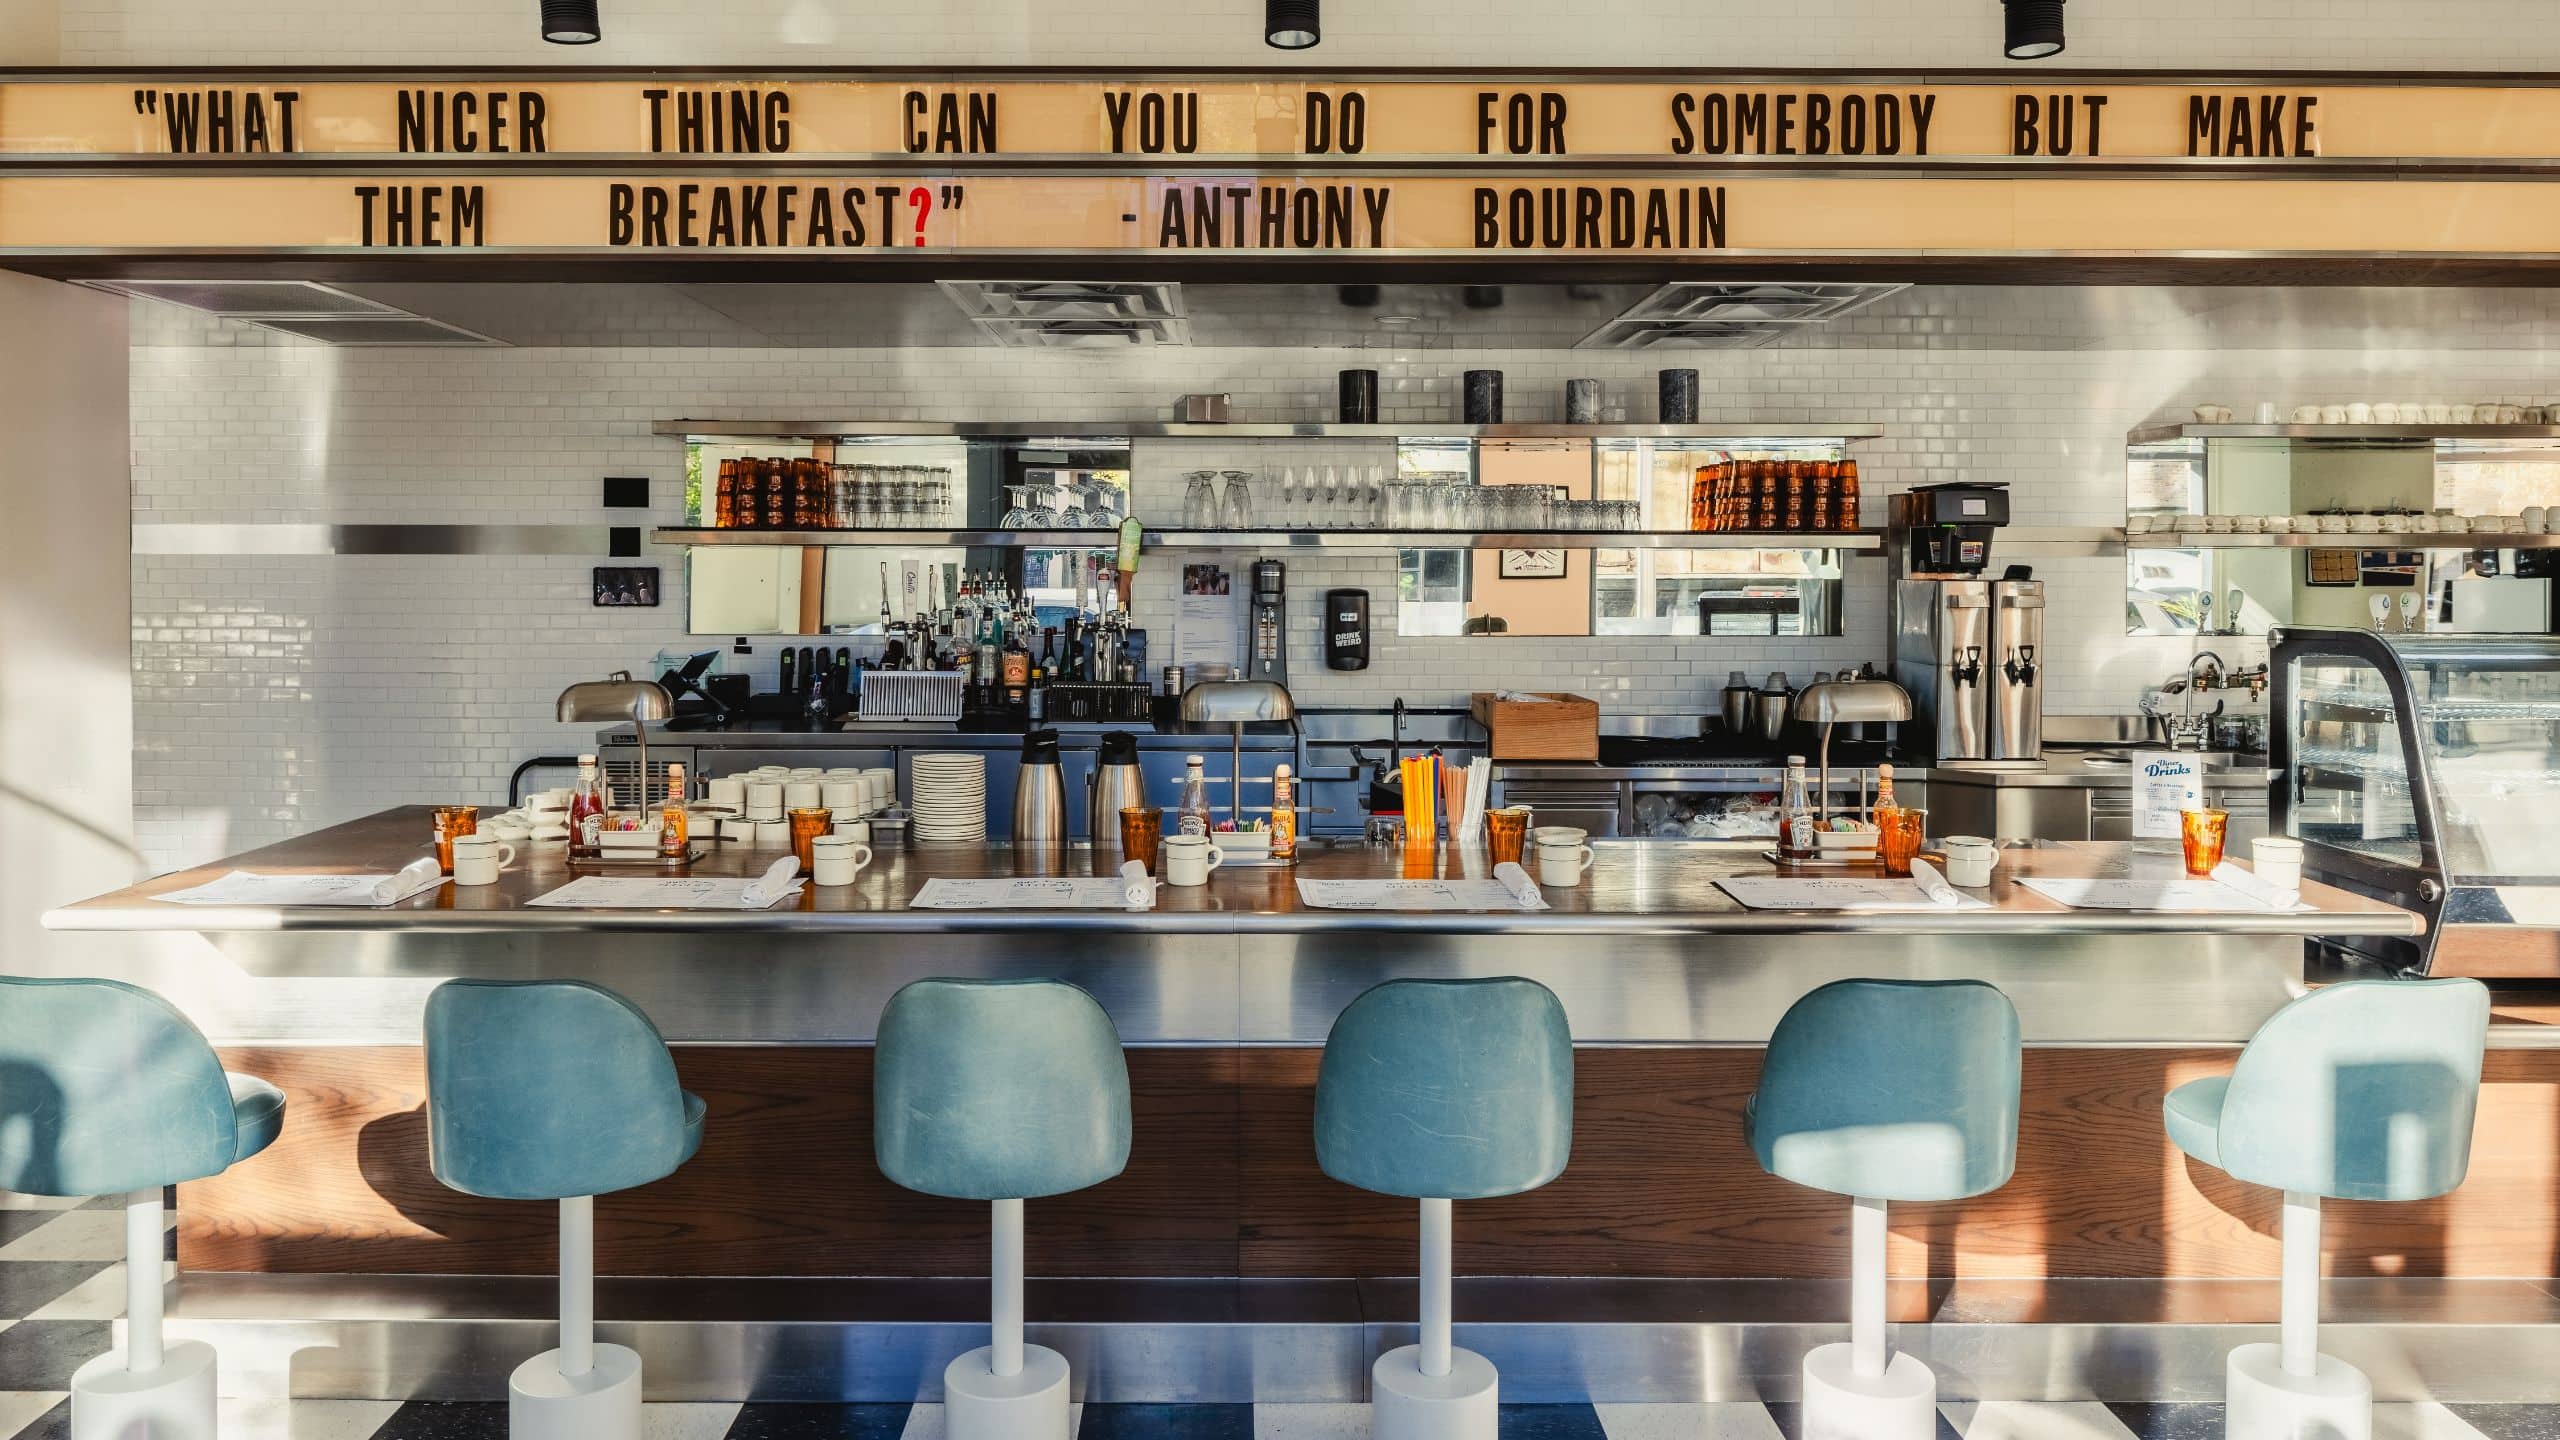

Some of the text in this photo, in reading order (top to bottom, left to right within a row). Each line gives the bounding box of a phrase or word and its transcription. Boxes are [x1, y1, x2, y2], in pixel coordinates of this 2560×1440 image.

[398, 89, 545, 153] NICER
[643, 89, 790, 153] THING
[906, 91, 996, 154] CAN
[1104, 92, 1197, 154] YOU
[1305, 91, 1365, 154] DO
[1478, 92, 1567, 155] FOR
[1671, 92, 1935, 155] SOMEBODY
[2014, 94, 2108, 157] BUT
[2188, 94, 2319, 158] MAKE
[355, 186, 484, 247] THEM
[1159, 185, 1390, 249] ANTHONY
[1474, 186, 1726, 249] BOURDAIN
[1335, 631, 1361, 641] DRINK
[1335, 639, 1362, 648] WEIRD
[2144, 764, 2191, 777] Drinks
